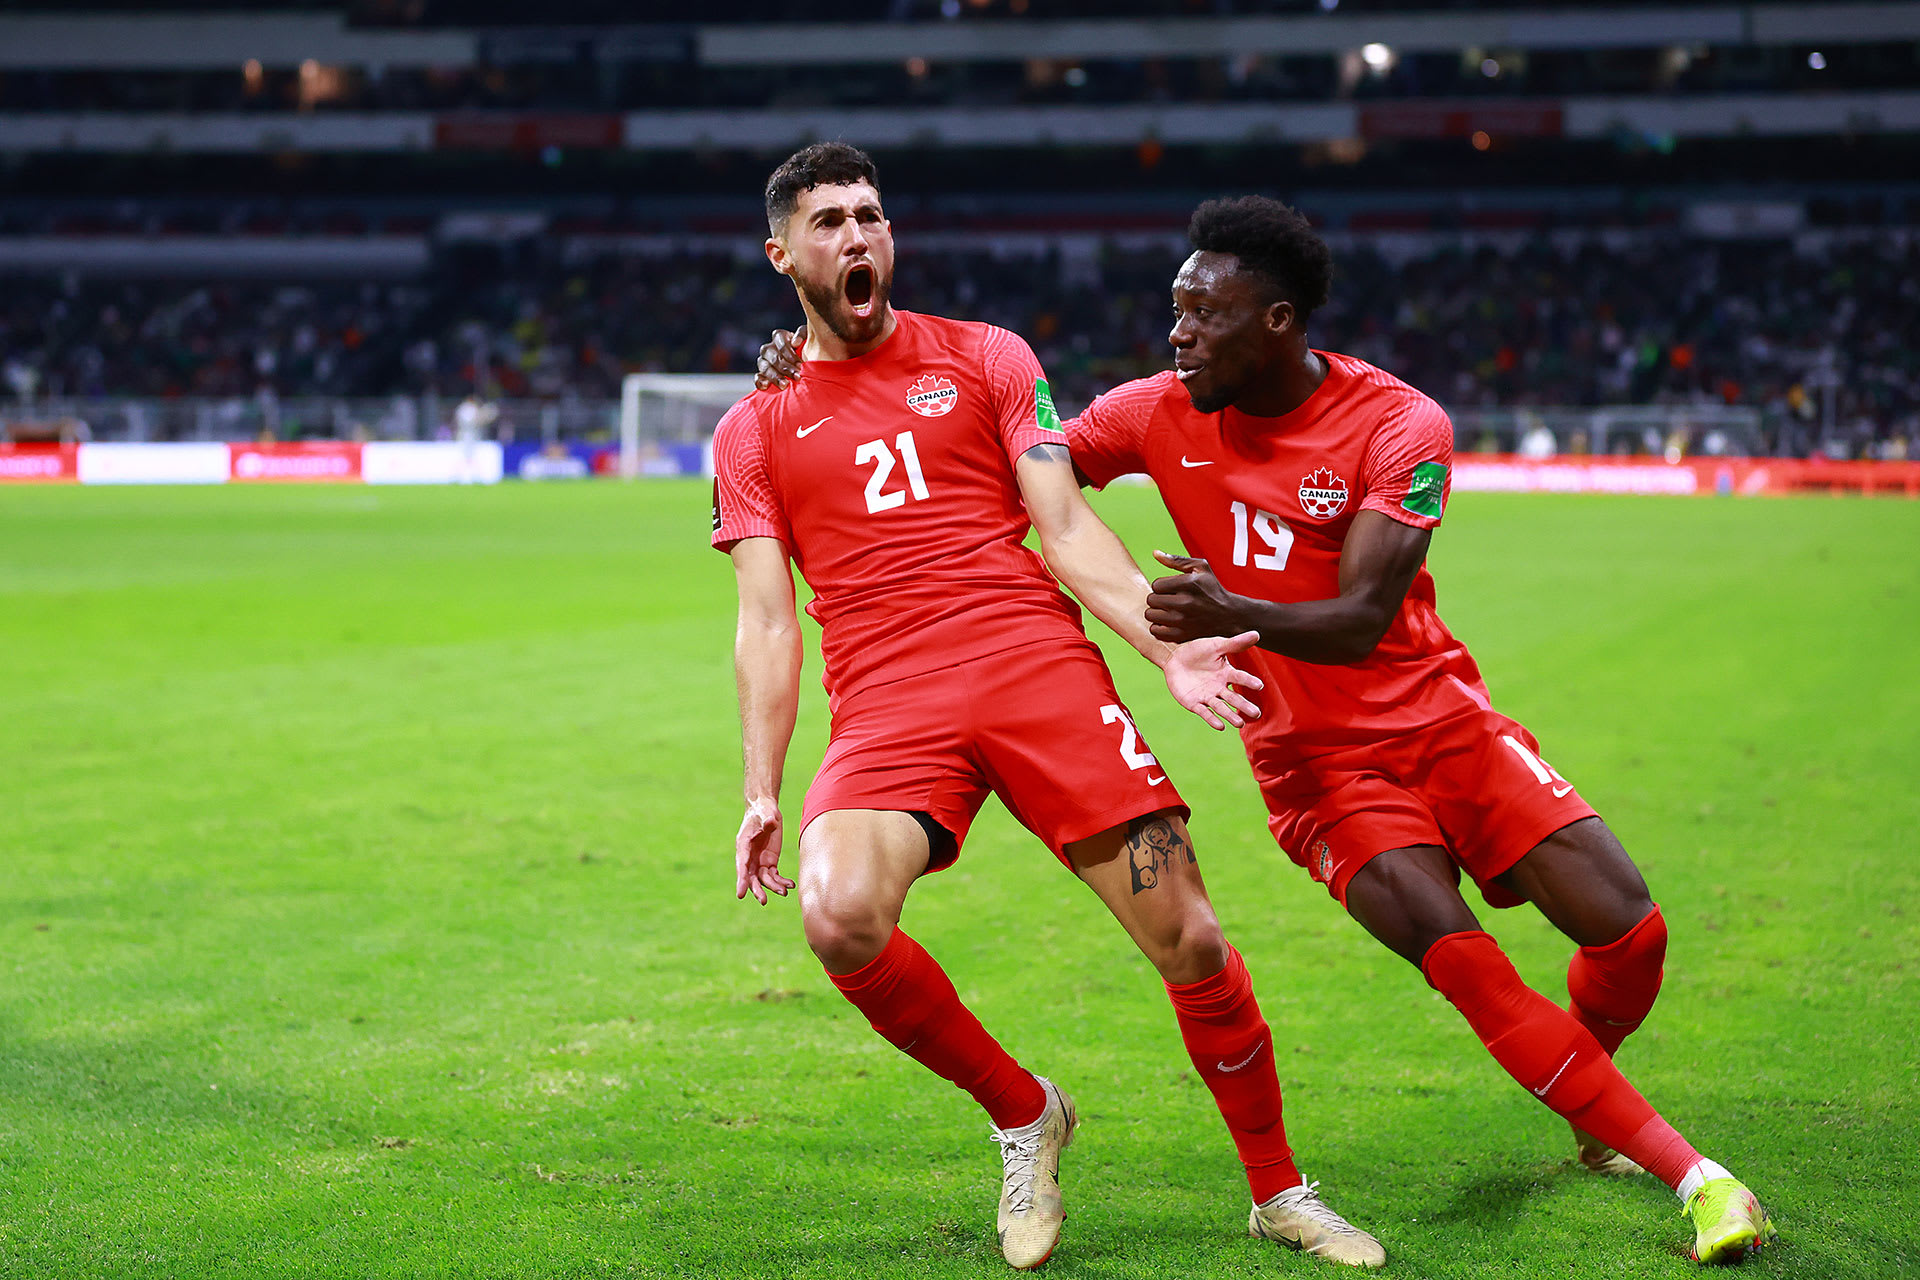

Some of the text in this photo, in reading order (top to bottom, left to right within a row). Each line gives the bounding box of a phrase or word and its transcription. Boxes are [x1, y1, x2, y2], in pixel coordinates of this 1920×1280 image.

[908, 389, 956, 404] CANADA
[855, 430, 930, 514] 21
[1300, 489, 1347, 500] CANADA
[1230, 501, 1294, 571] 19
[1100, 704, 1157, 771] 2
[1502, 735, 1567, 785] 1
